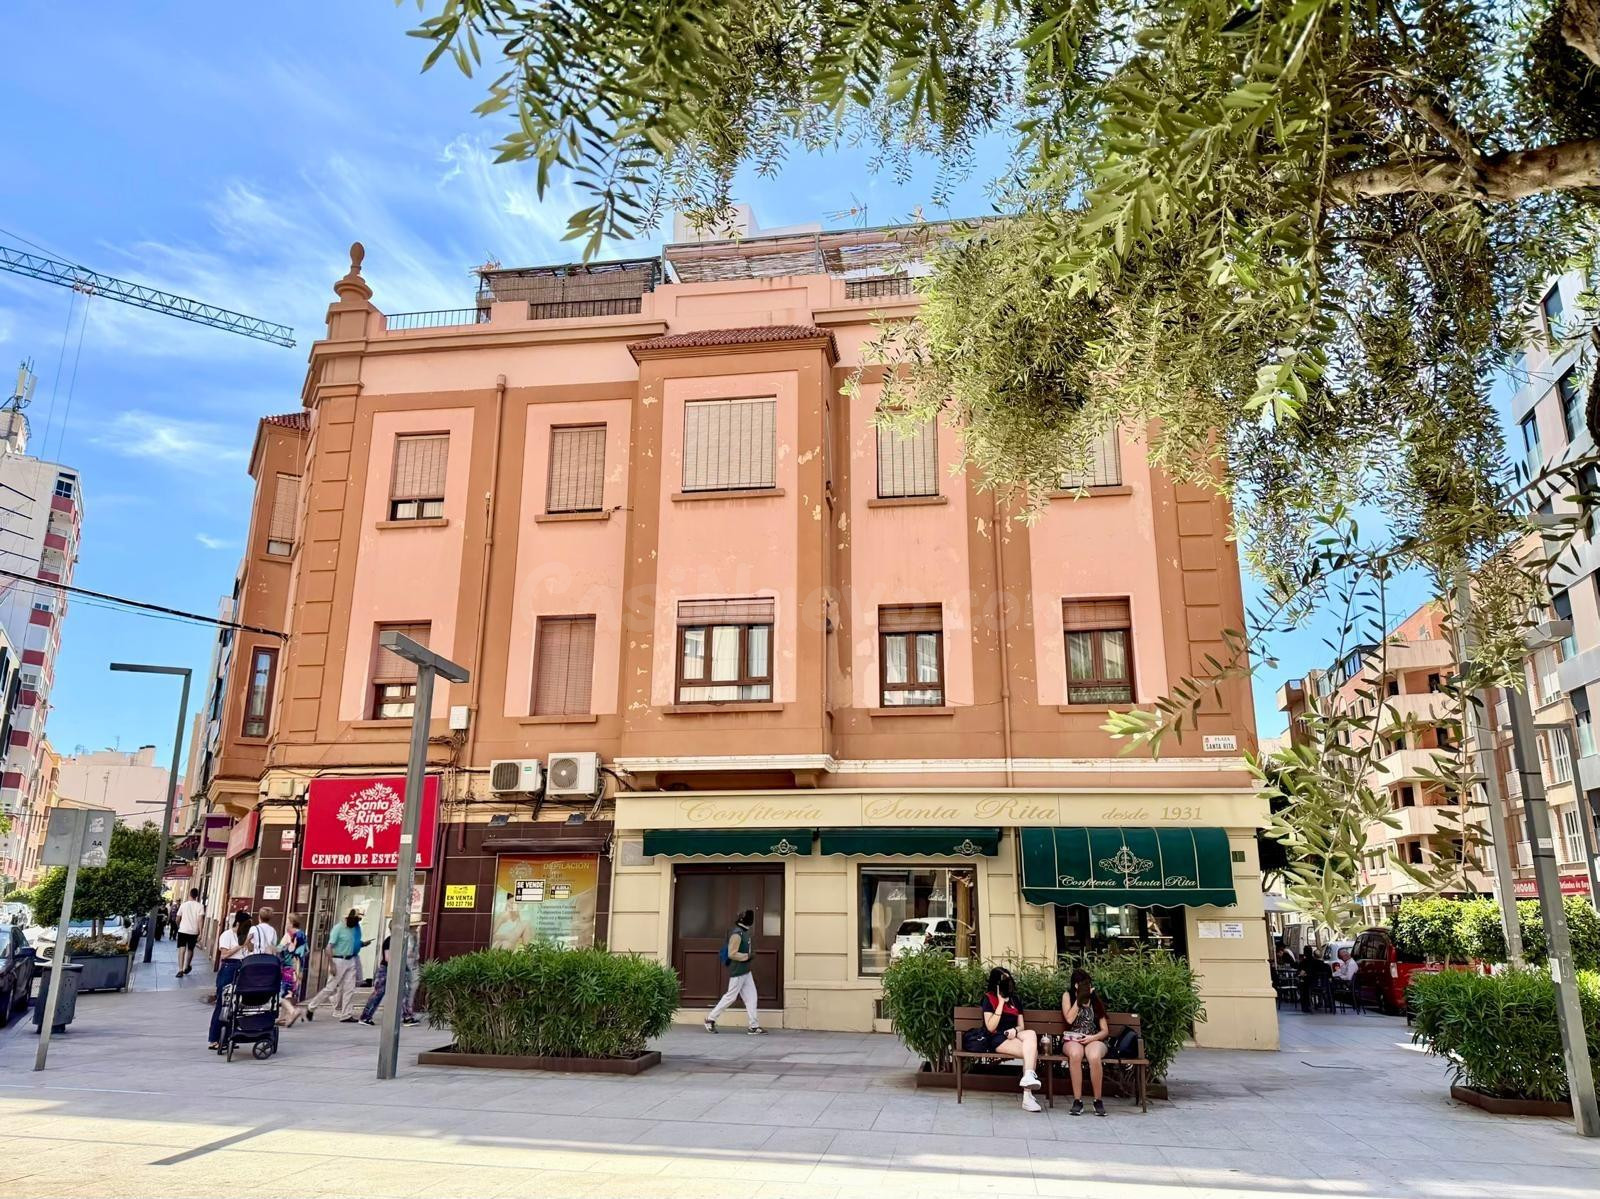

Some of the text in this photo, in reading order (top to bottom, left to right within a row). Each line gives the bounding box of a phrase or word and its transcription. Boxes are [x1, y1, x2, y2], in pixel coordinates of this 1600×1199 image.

[355, 798, 389, 810] Santa
[679, 794, 1203, 826] Confitería Santa Rita desde 1931
[356, 810, 384, 823] Rita
[311, 853, 351, 865] CENTRO
[354, 853, 368, 864] DE
[1058, 874, 1197, 888] Confitería Santa Rita
